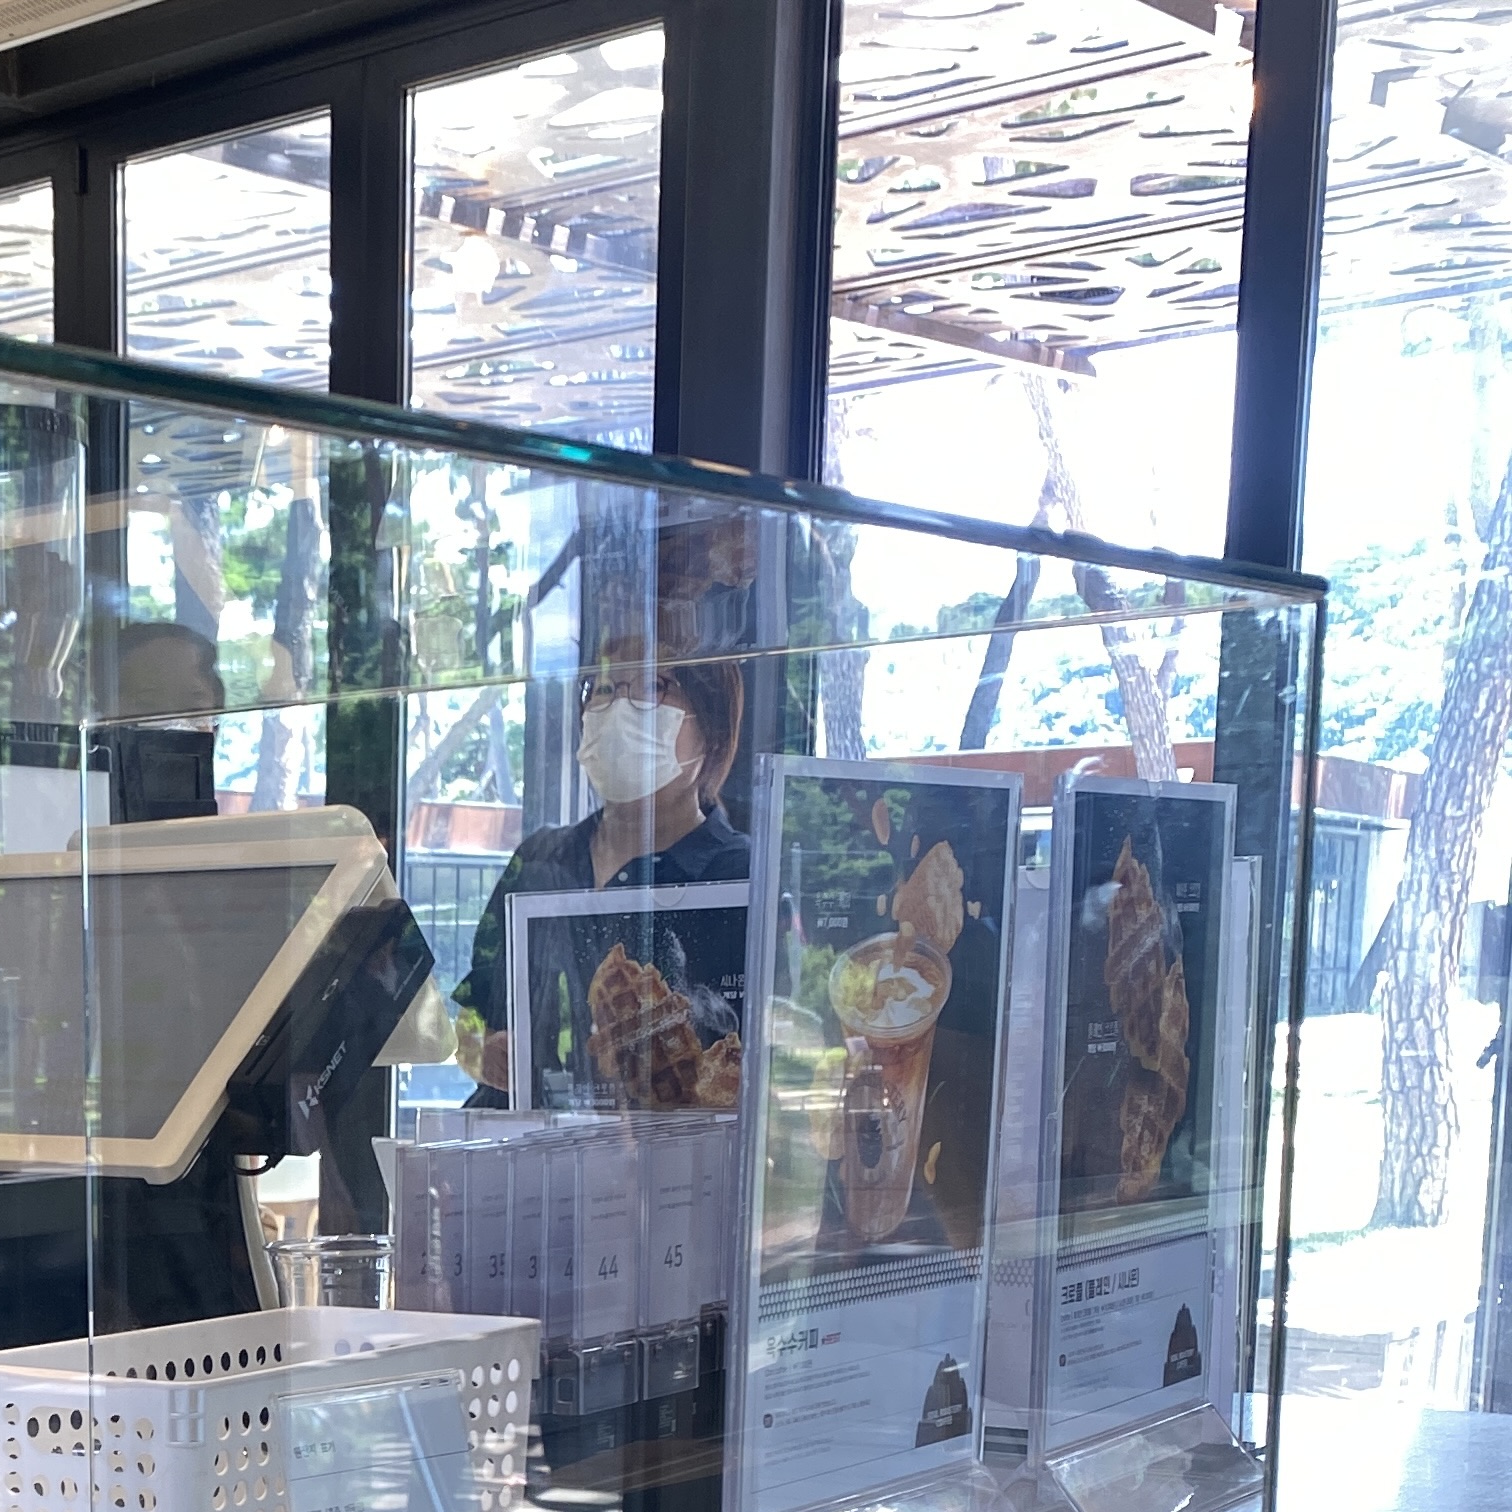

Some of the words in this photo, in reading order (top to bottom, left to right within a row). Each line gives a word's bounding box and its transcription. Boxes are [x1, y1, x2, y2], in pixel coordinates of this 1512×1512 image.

[314, 1040, 347, 1095] KSNET
[598, 1255, 619, 1280] 44
[664, 1244, 683, 1269] 45
[1061, 1282, 1083, 1305] 크로플
[766, 1328, 819, 1359] 옥수수커피
